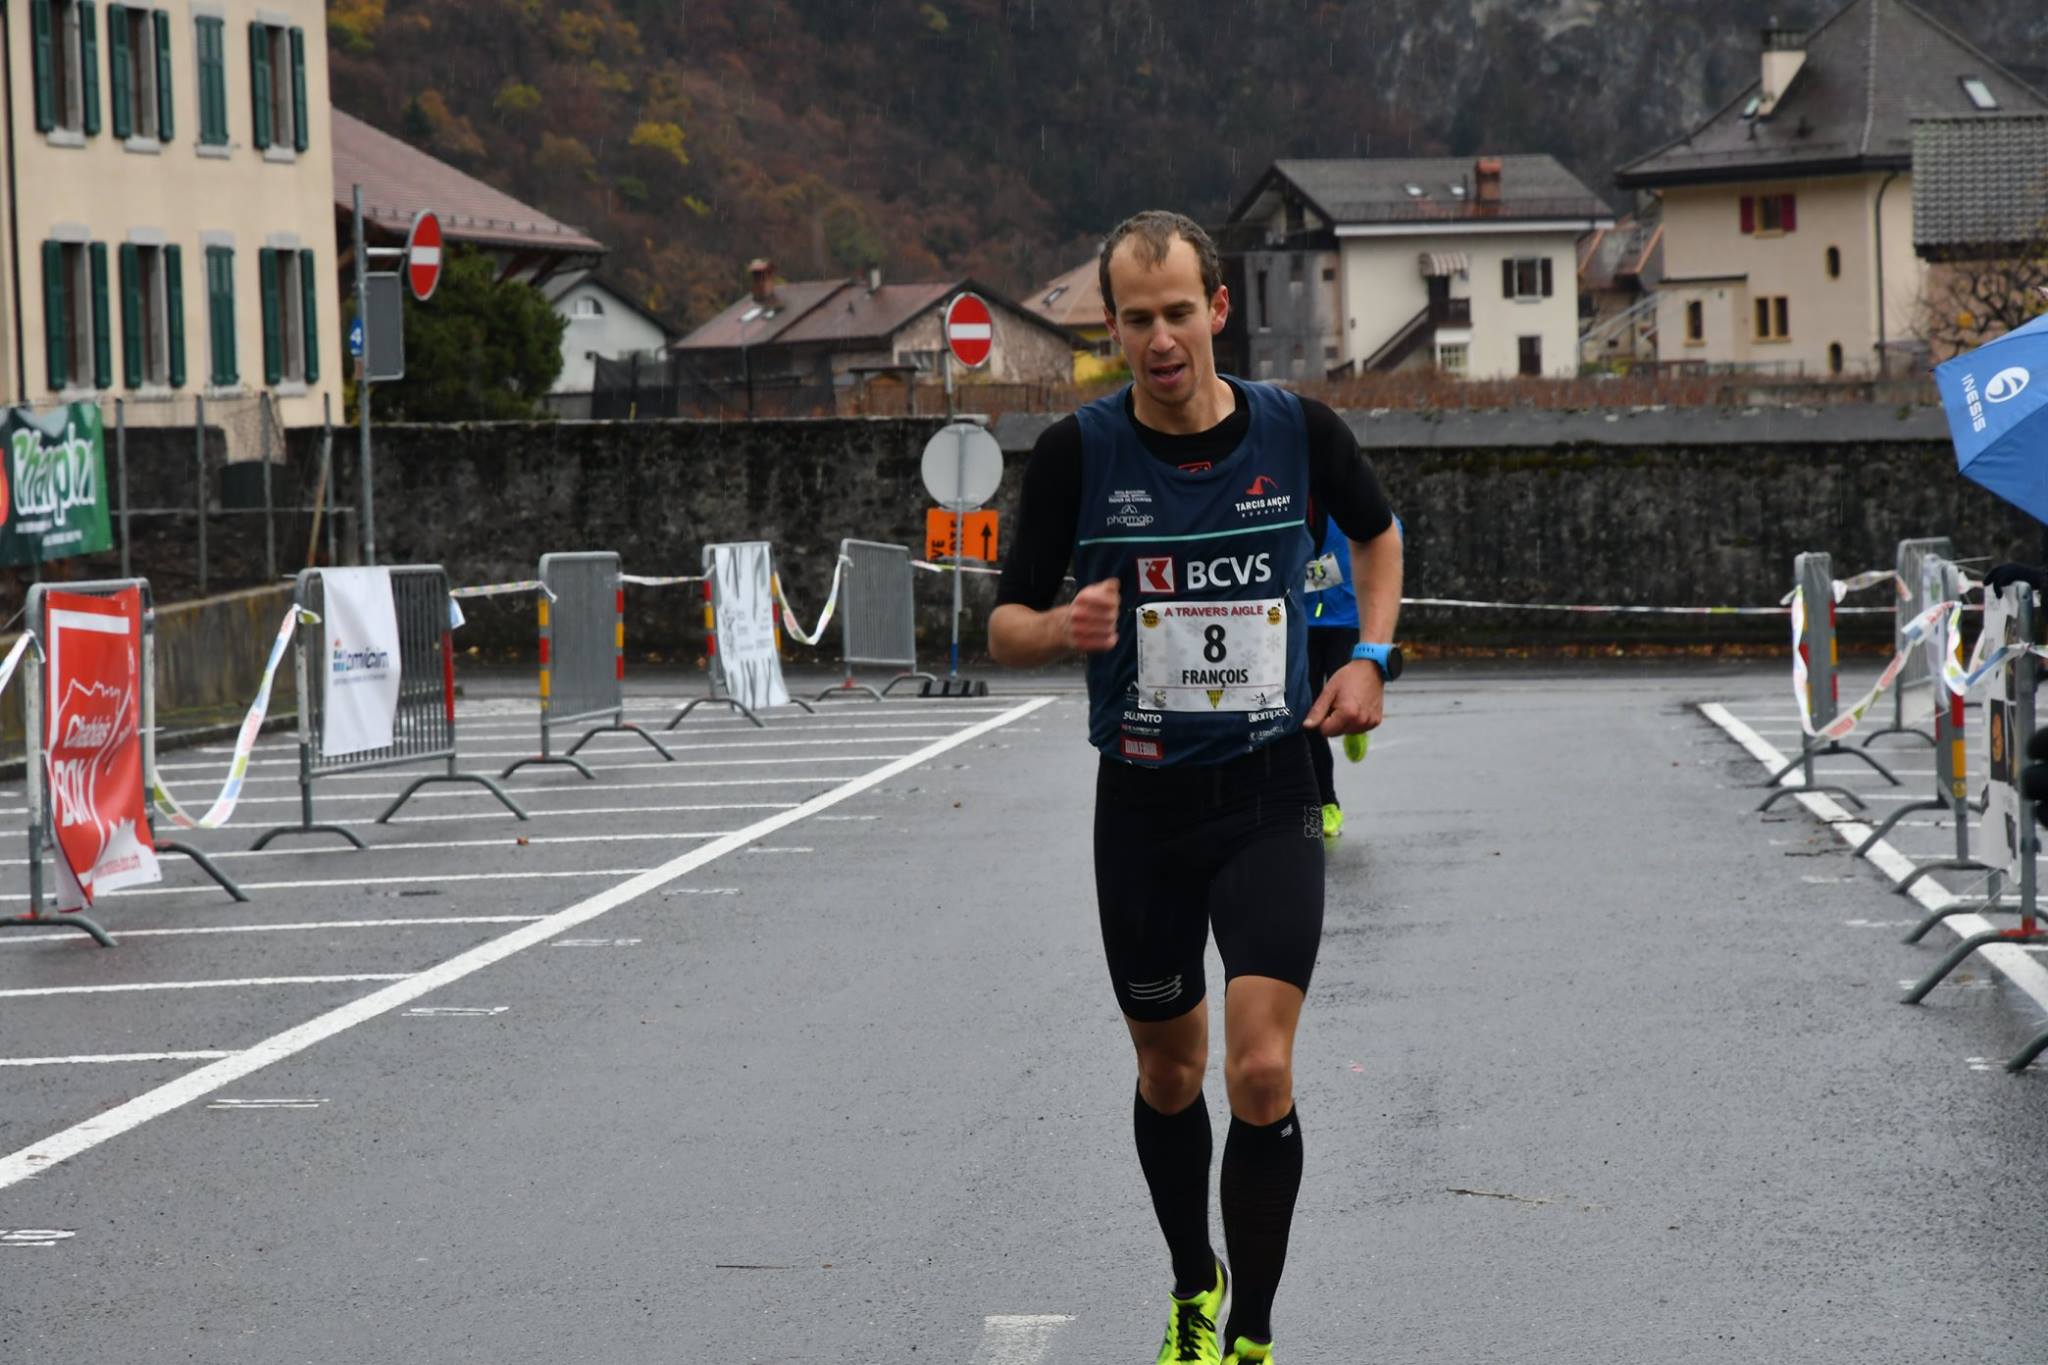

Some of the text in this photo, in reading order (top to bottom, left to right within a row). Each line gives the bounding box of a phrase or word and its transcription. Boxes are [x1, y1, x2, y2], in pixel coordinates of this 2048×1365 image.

[1961, 373, 1986, 433] INESIS
[1235, 495, 1291, 512] TARCIS ANÇAY
[1187, 553, 1272, 590] BCVS
[1164, 605, 1264, 617] A TRAVERS AIGLE
[1203, 624, 1227, 663] 8
[1182, 669, 1249, 688] FRANÇOIS
